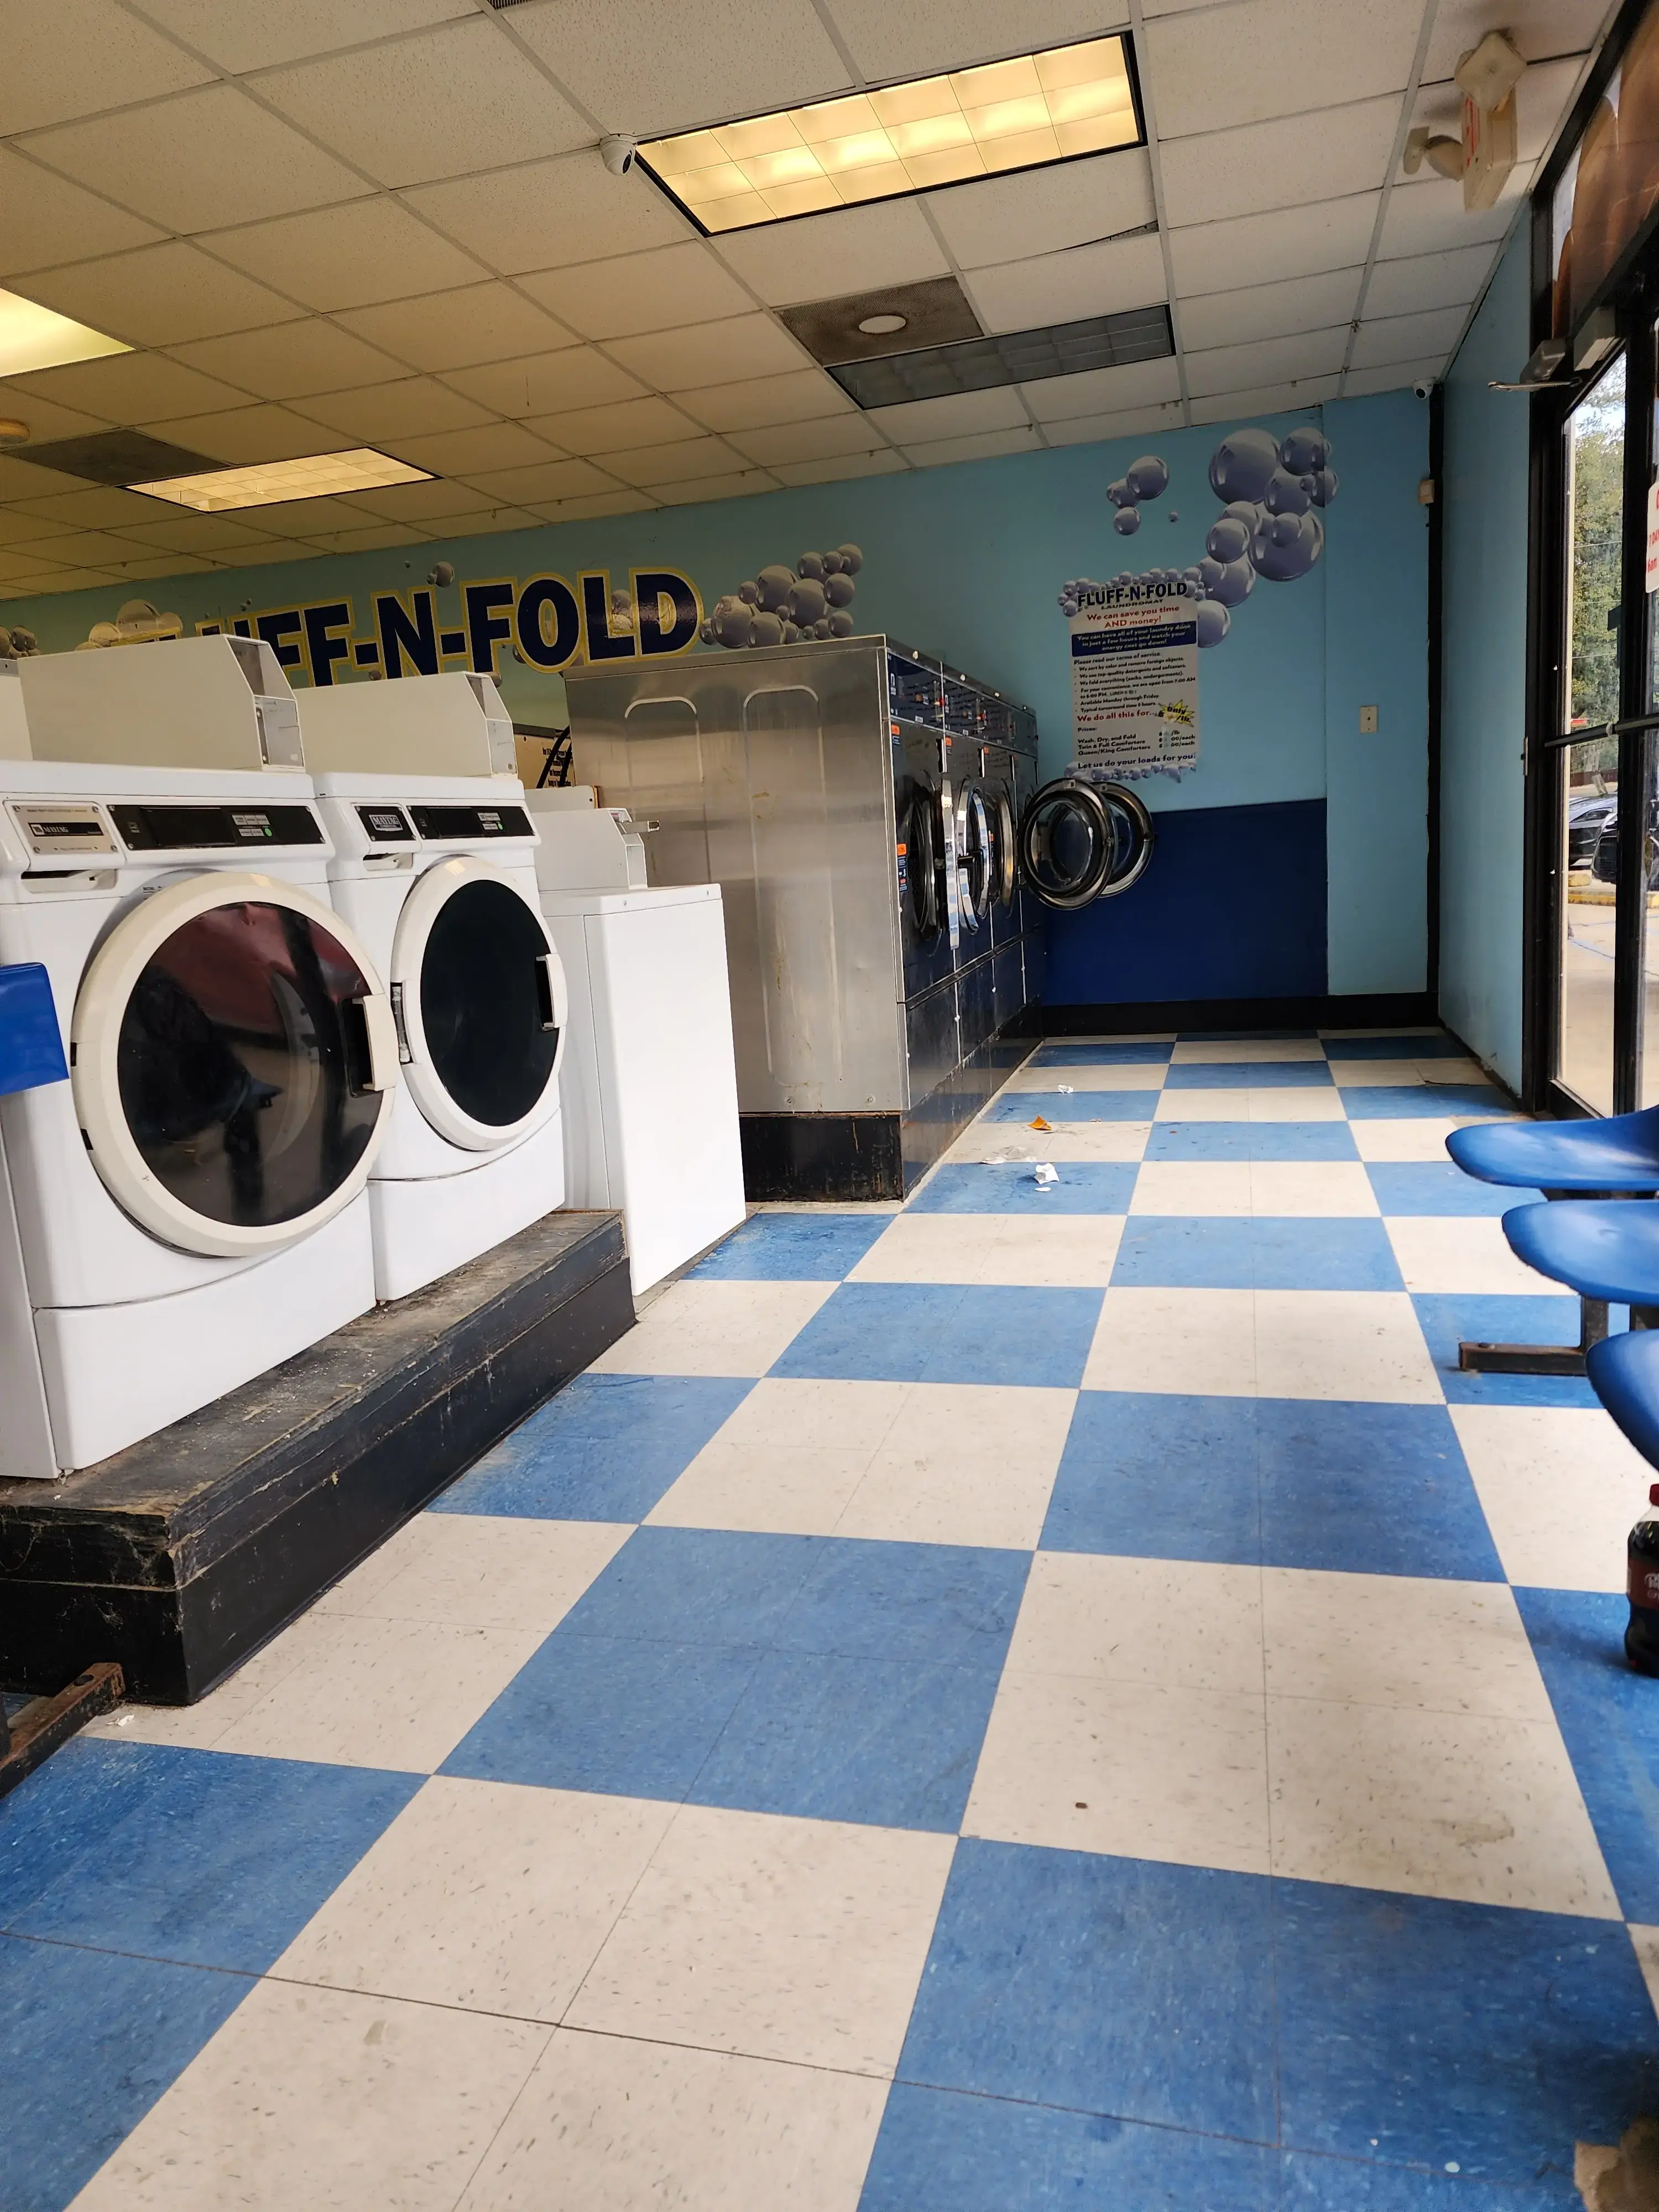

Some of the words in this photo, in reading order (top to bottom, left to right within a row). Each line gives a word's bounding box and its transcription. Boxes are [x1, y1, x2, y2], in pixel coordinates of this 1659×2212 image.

[1078, 582, 1187, 607] FLUFF-N-FOLD
[1101, 599, 1164, 610] LAUNDROMAT
[1141, 609, 1157, 617] you
[1104, 620, 1127, 629] AND
[1130, 615, 1162, 625] money!
[1167, 706, 1186, 714] Only
[1138, 755, 1161, 764] loads
[372, 817, 399, 825] MAYTAG
